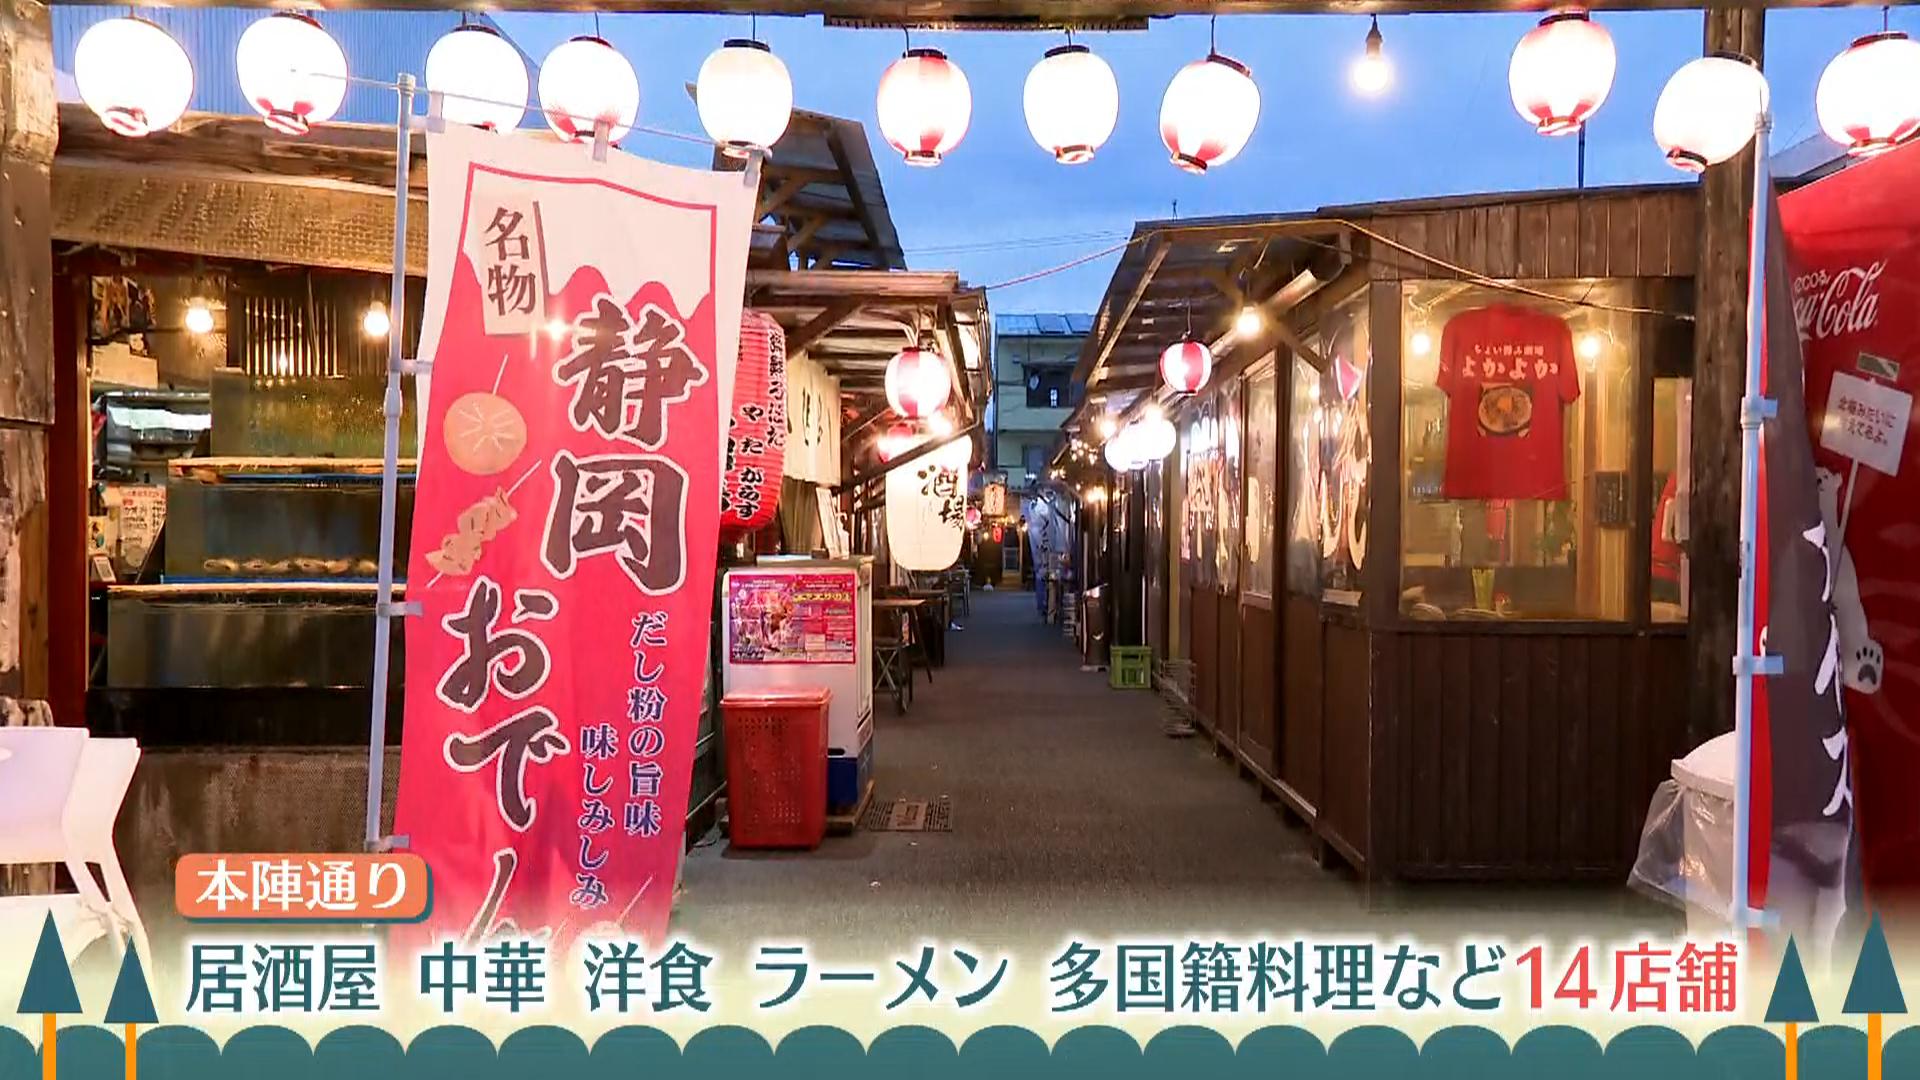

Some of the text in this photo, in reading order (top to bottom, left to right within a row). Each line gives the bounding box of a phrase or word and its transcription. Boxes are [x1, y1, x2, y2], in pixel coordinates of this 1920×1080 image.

[484, 206, 537, 316] 名物
[1794, 259, 1888, 339] ca-Cola
[1462, 355, 1559, 381] よかよか
[543, 294, 708, 595] 静岡
[735, 403, 765, 519] やたがらす
[1842, 416, 1888, 446] えてるよ。
[917, 464, 965, 532] 酒場
[624, 613, 669, 837] だし粉の旨味
[571, 724, 618, 909] 味しみしみ
